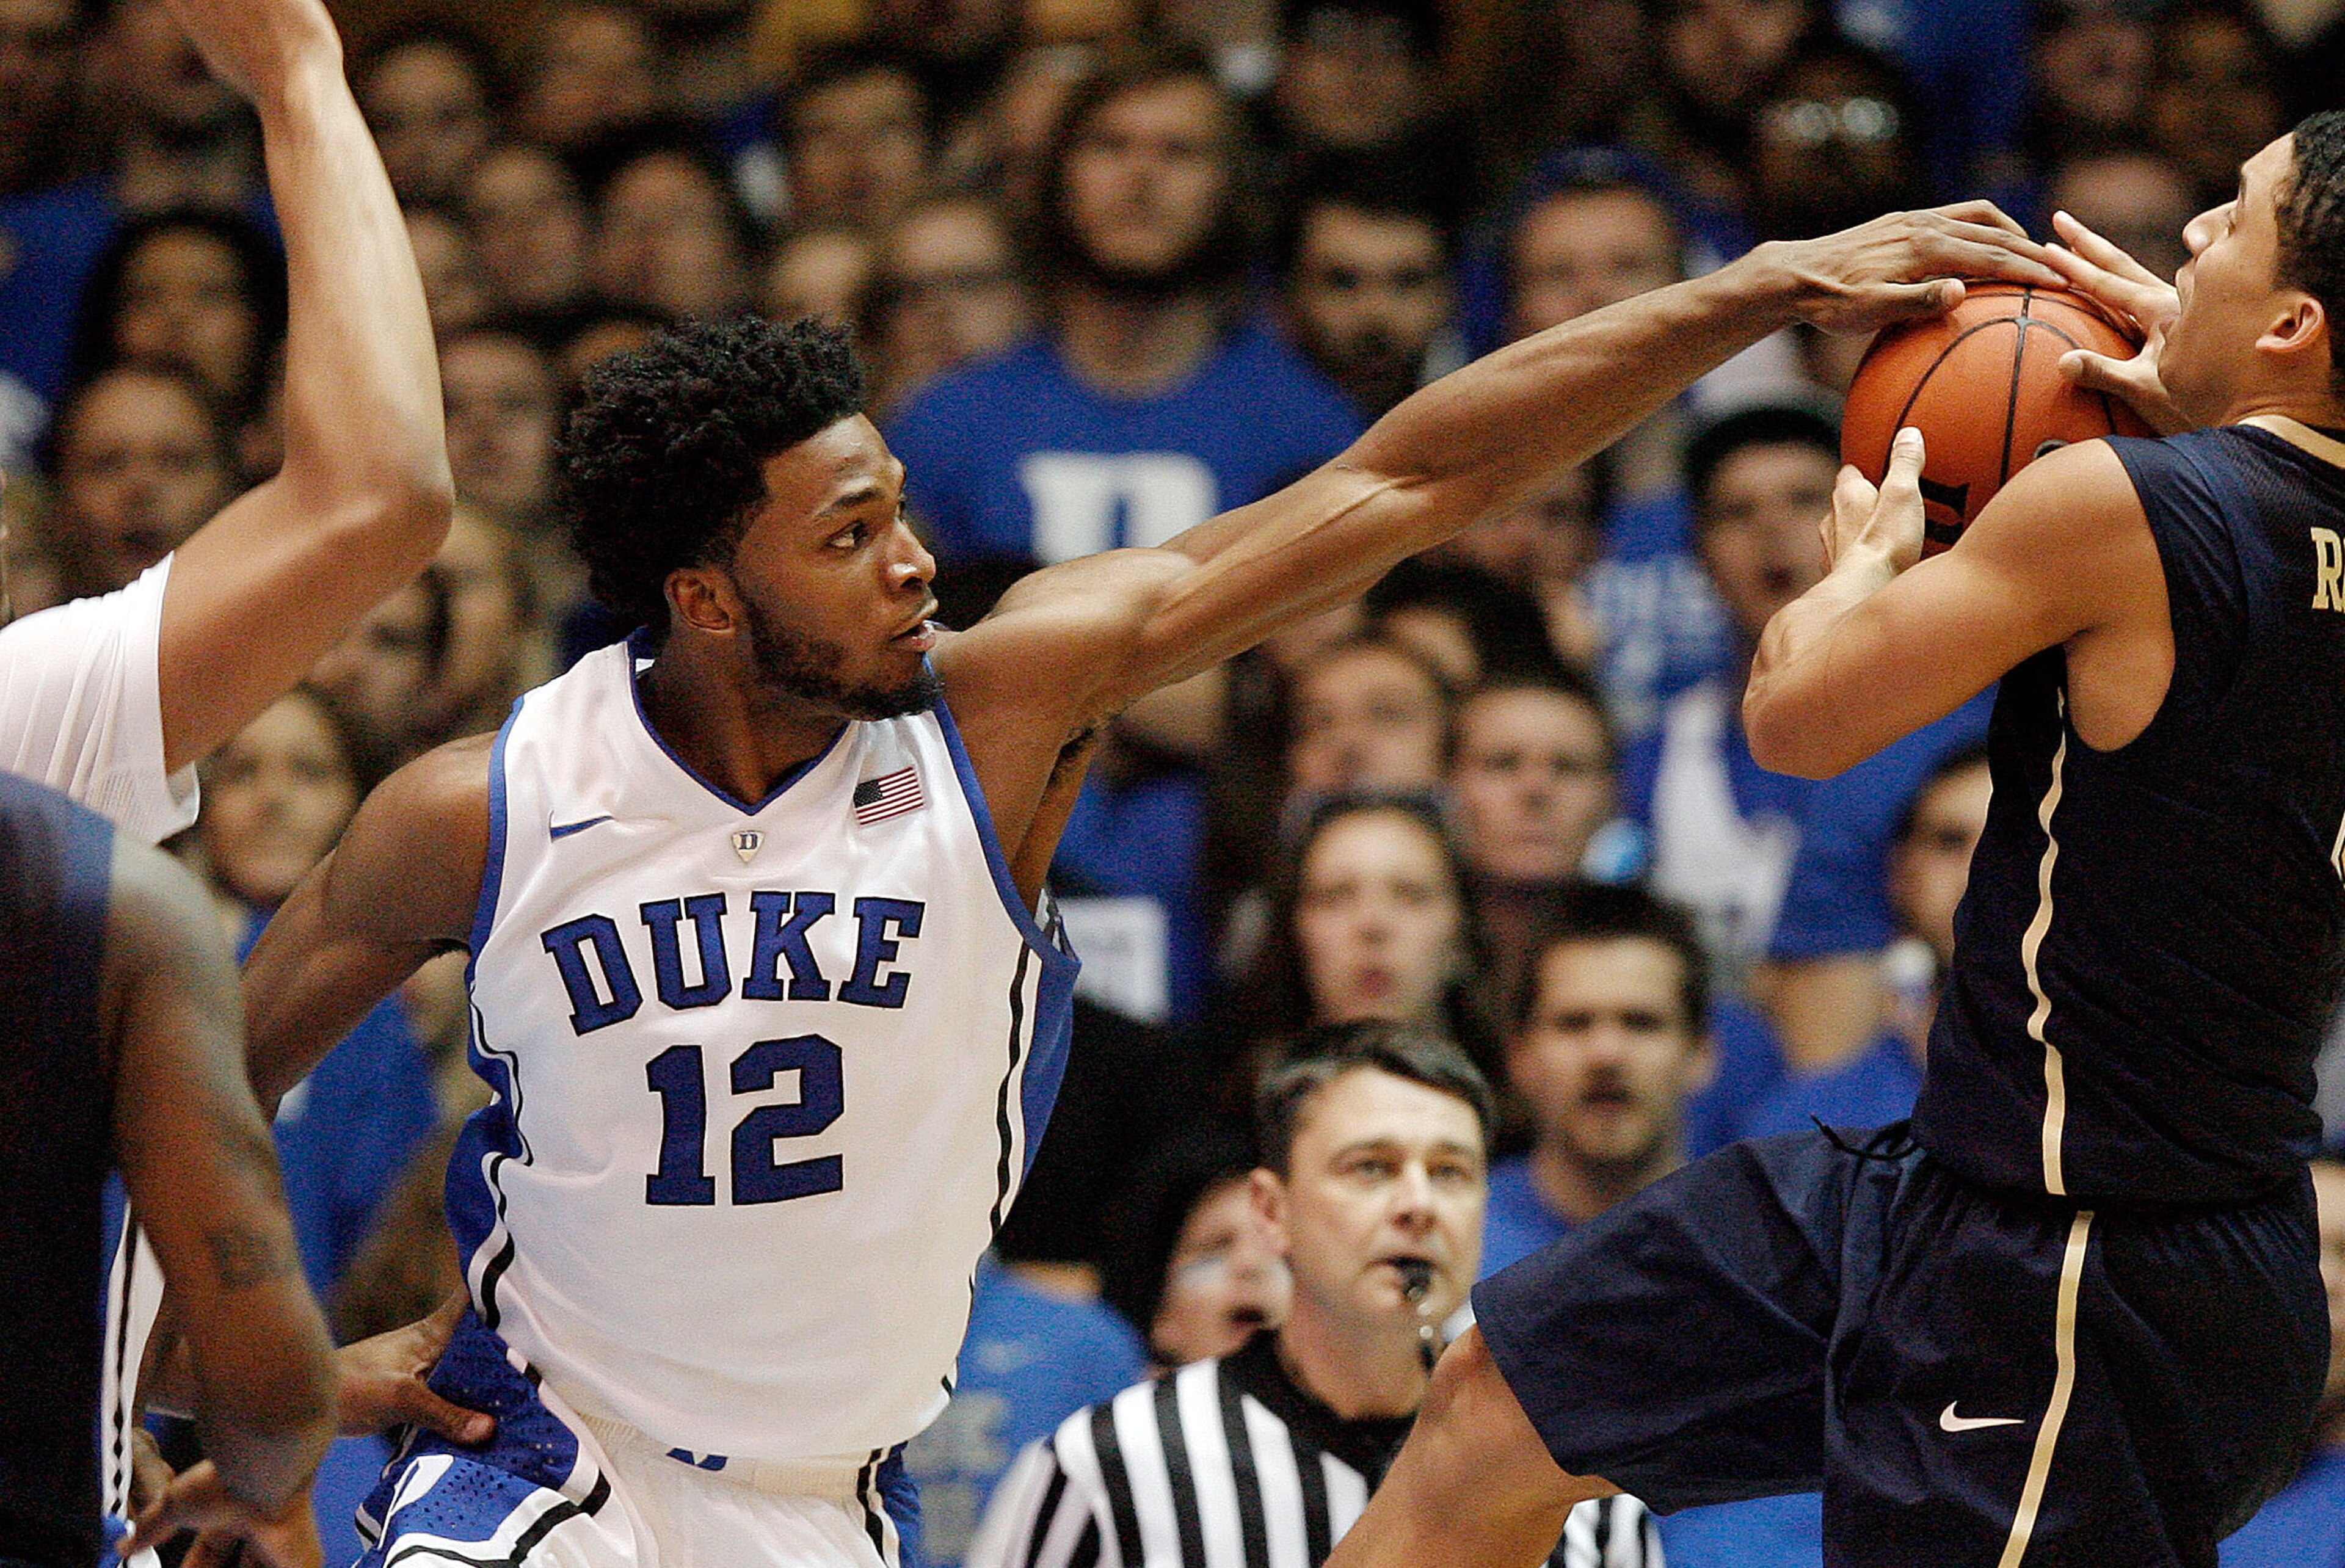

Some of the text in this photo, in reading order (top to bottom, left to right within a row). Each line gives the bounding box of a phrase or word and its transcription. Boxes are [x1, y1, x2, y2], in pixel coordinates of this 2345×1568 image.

[2310, 526, 2345, 613] R
[738, 833, 758, 849] D
[540, 890, 925, 1036] DUKE
[645, 1033, 845, 1206] 12
